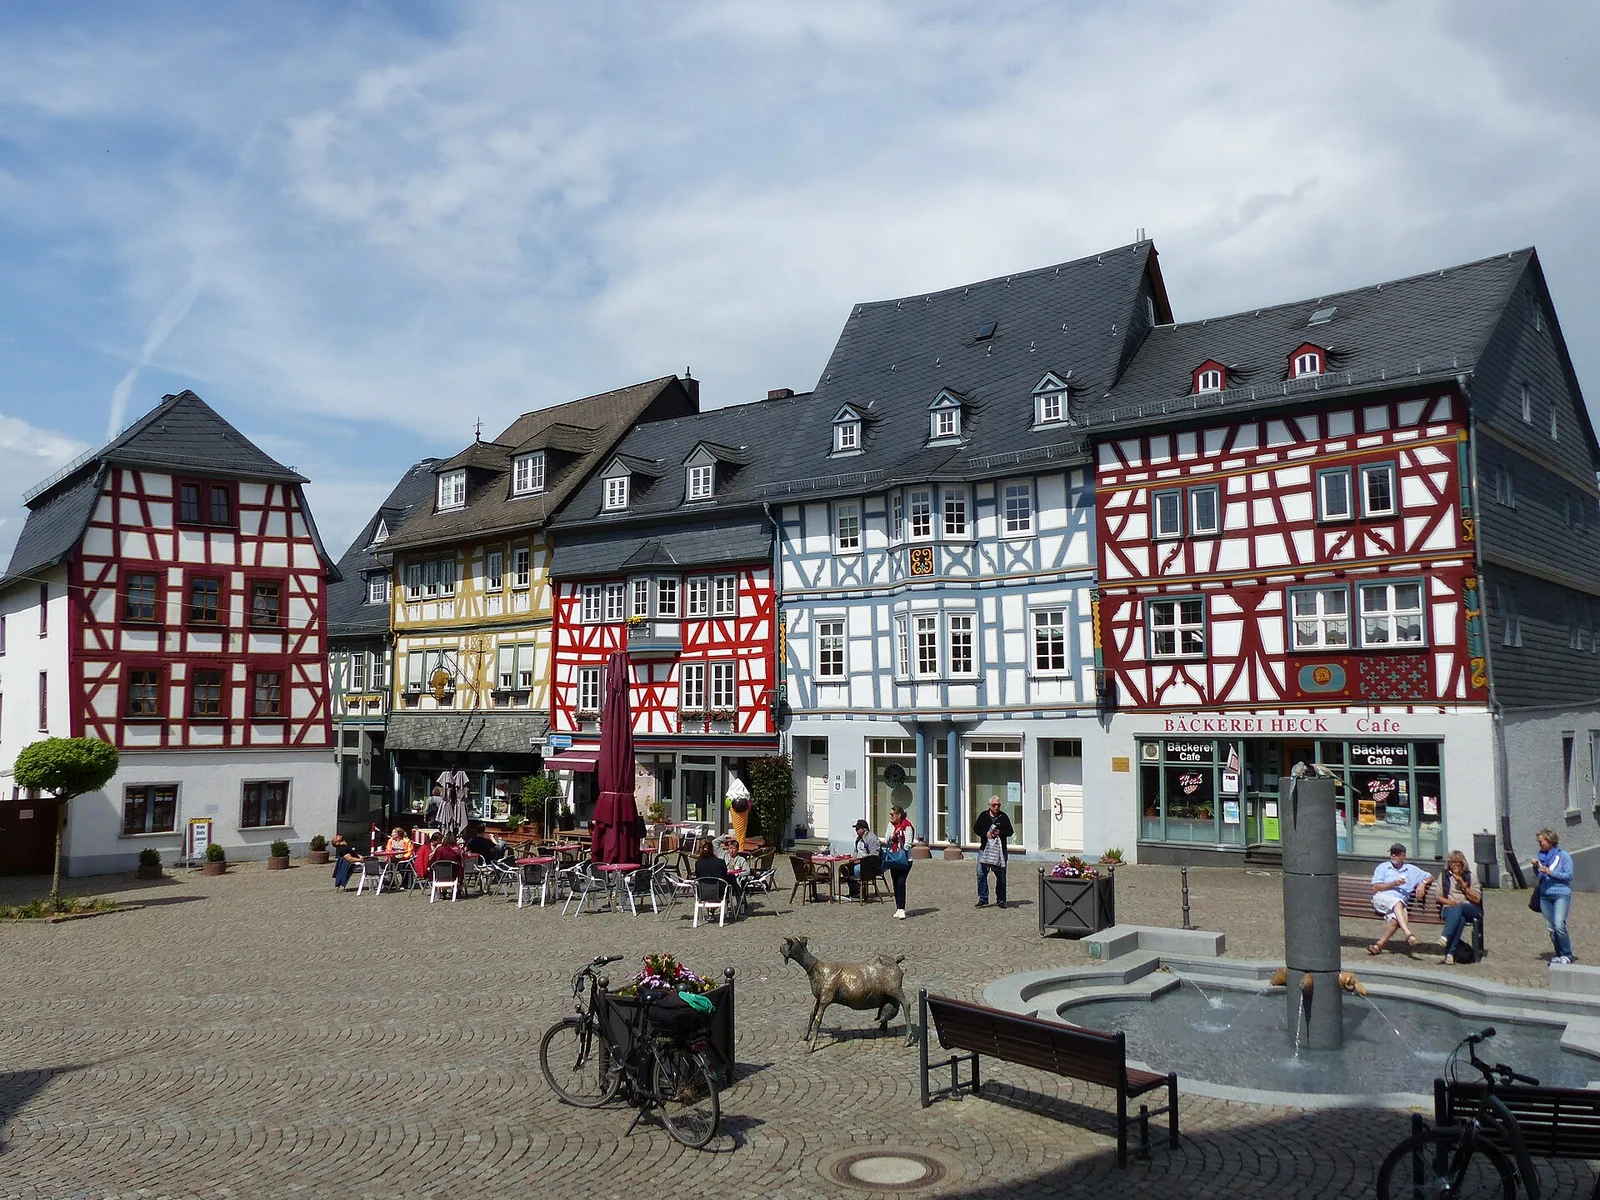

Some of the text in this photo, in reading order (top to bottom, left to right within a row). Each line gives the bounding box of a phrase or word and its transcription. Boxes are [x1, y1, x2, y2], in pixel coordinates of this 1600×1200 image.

[1164, 716, 1400, 732] BÄCKEREI HECK Cafe
[1167, 742, 1213, 753] Bäckerei
[1352, 744, 1408, 755] Bäckerei
[1179, 752, 1201, 761] Cafe
[1367, 756, 1393, 765] Cafe
